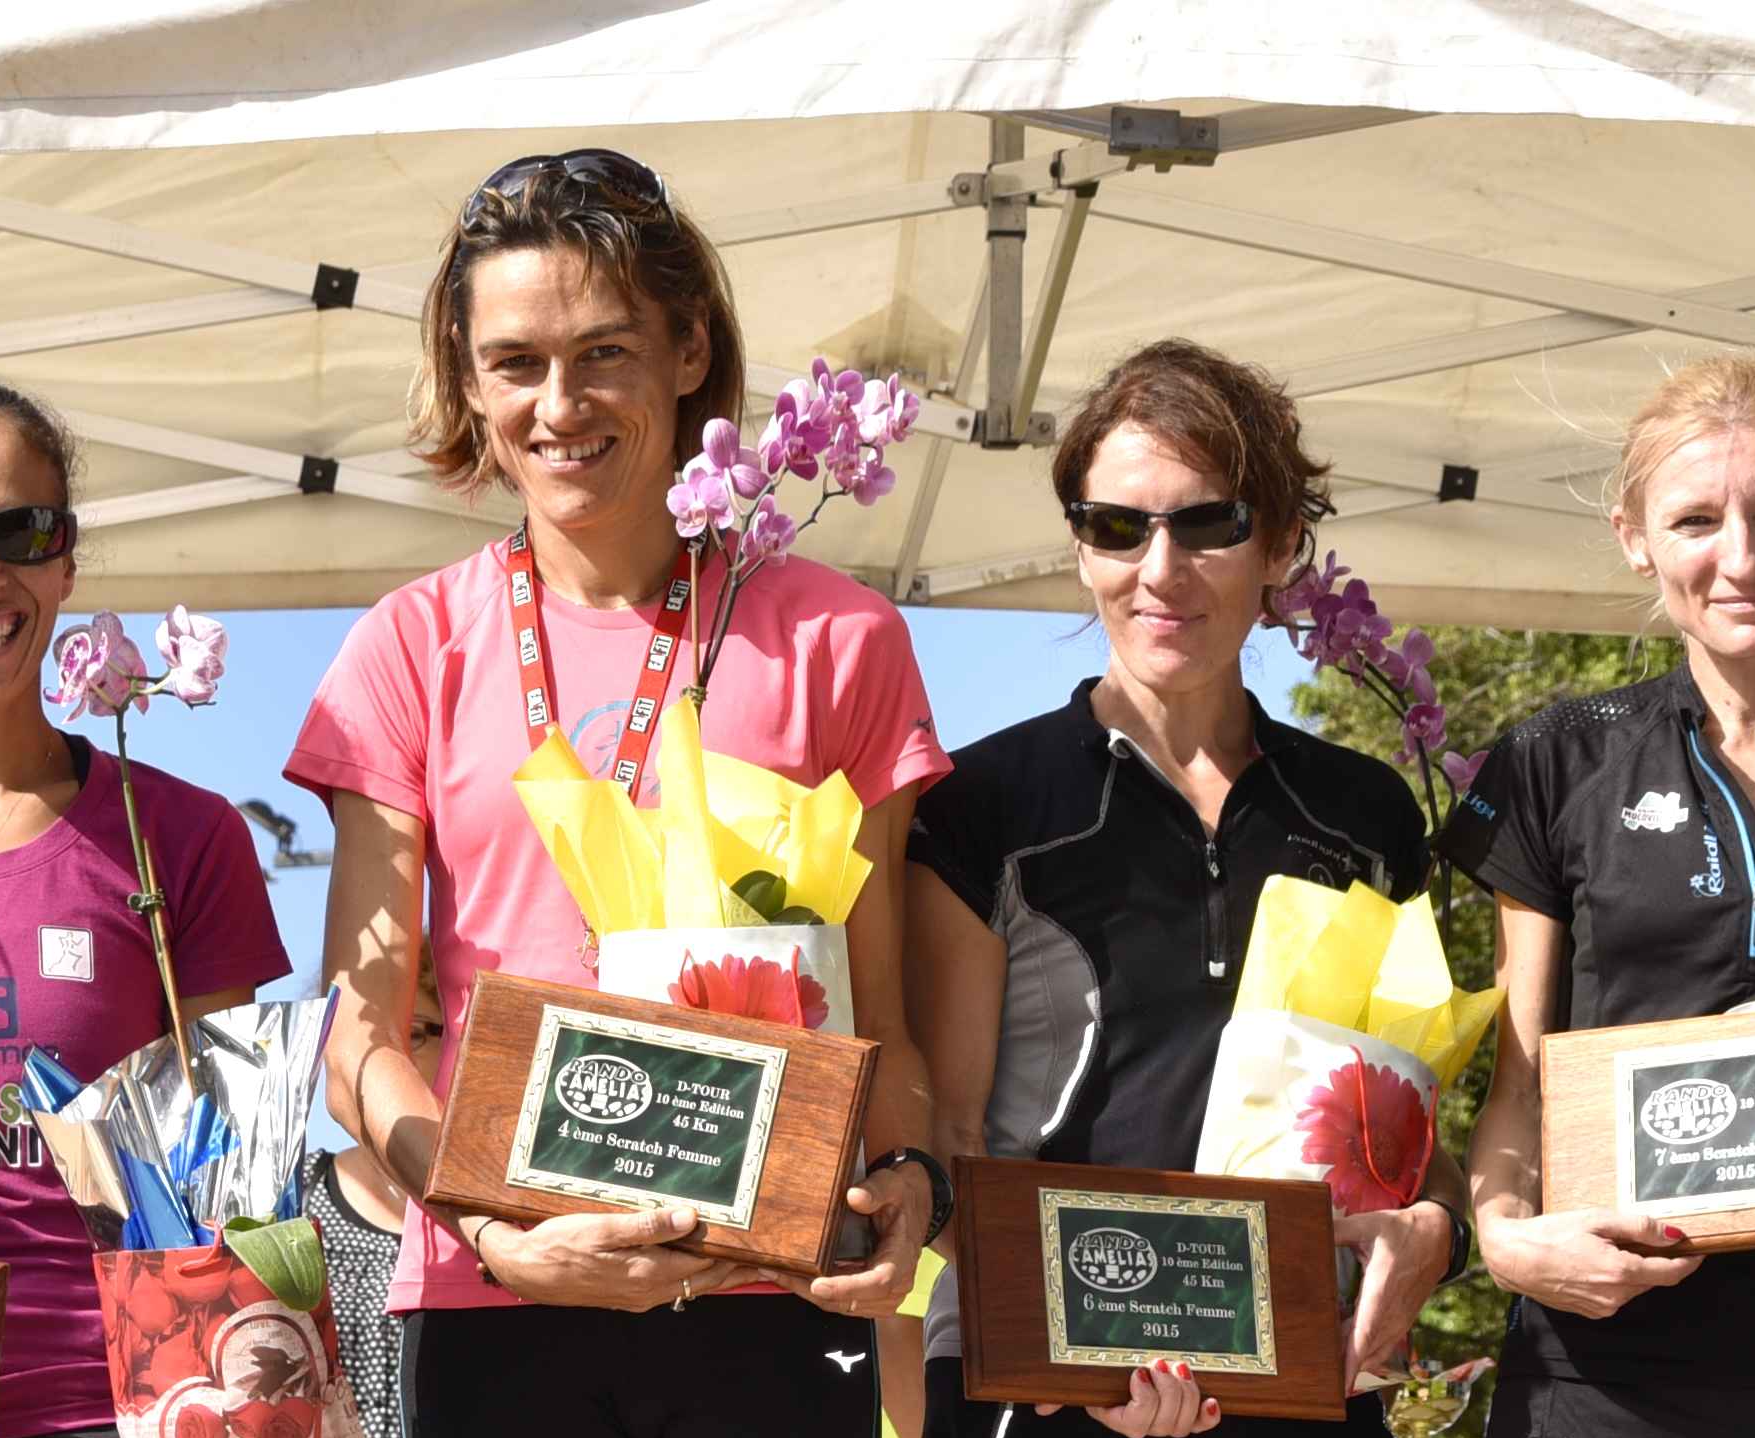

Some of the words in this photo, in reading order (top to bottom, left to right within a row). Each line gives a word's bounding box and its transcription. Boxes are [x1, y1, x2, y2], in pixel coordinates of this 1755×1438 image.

[569, 1057, 650, 1084] RANDO
[560, 1071, 650, 1103] CAMELIAS
[677, 1081, 731, 1100] D-TOUR
[1651, 1084, 1729, 1105] RANDO
[656, 1092, 669, 1105] 10
[672, 1095, 696, 1110] ème
[700, 1100, 745, 1120] Edition
[672, 1115, 689, 1129] 45
[693, 1117, 719, 1135] Km
[557, 1120, 570, 1137] 4
[573, 1126, 603, 1144] ème
[606, 1132, 663, 1156] Scratch
[666, 1144, 721, 1167] Femme
[1654, 1148, 1667, 1166] 7
[614, 1157, 655, 1178] 2015
[1716, 1163, 1755, 1182] 2015
[1075, 1232, 1150, 1250] RANDO
[1176, 1242, 1227, 1255] D-TOUR
[1072, 1248, 1156, 1267] CAMELIAS
[1161, 1257, 1174, 1267] 10
[1177, 1256, 1199, 1270] ème
[1202, 1259, 1244, 1272] Edition
[1182, 1274, 1198, 1287] 45
[1201, 1274, 1225, 1289] Km
[1083, 1292, 1095, 1311] 6
[1098, 1298, 1126, 1313] ème
[1130, 1300, 1182, 1316] Scratch
[1186, 1304, 1236, 1319] Femme
[1142, 1322, 1180, 1338] 2015
